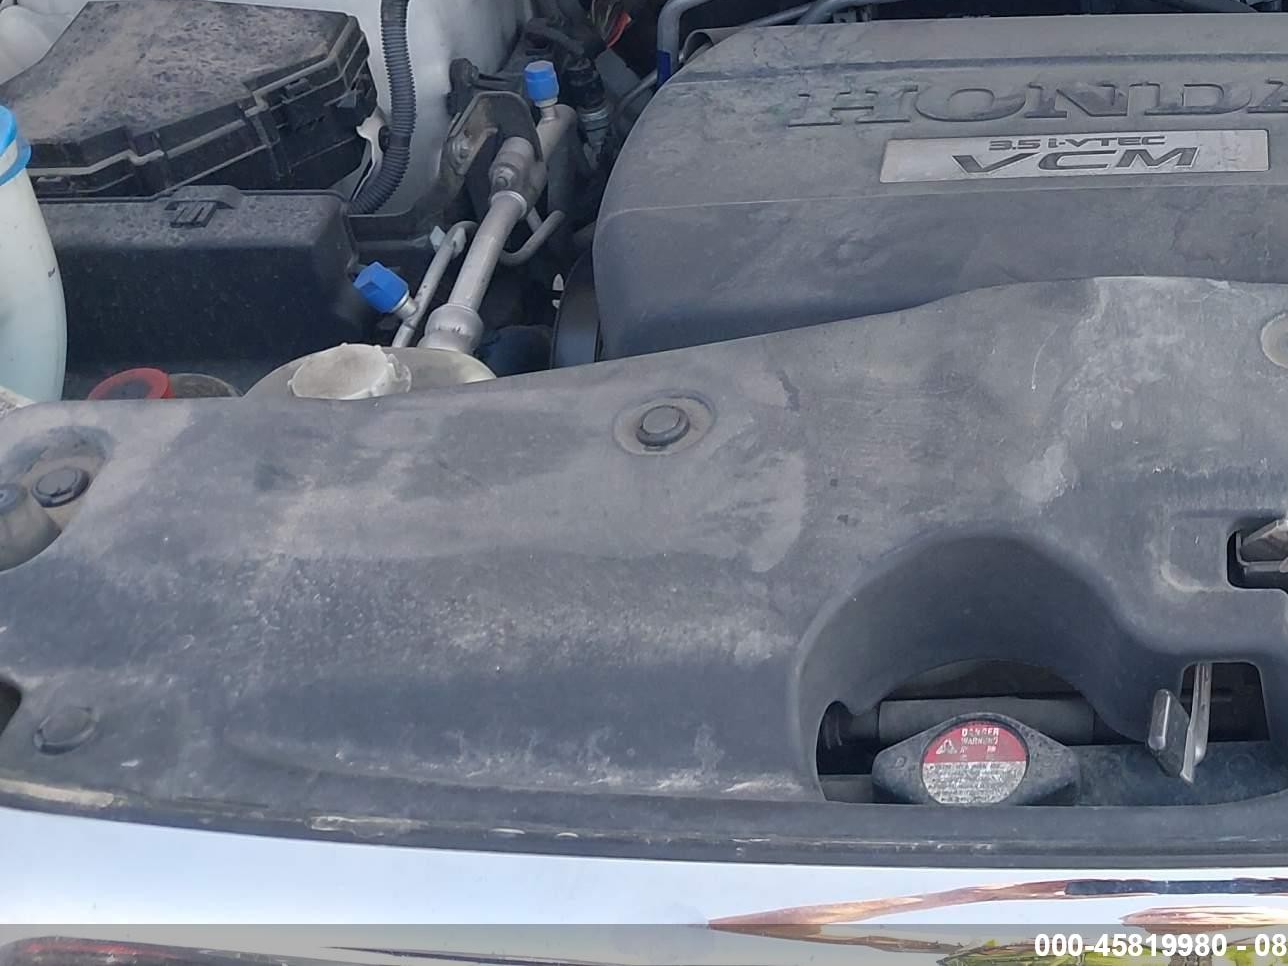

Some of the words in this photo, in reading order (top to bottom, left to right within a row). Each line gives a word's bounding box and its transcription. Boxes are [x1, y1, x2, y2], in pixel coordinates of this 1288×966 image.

[988, 138, 1041, 151] 3.5
[1047, 135, 1166, 149] i-VTEC
[951, 146, 1200, 174] VCM
